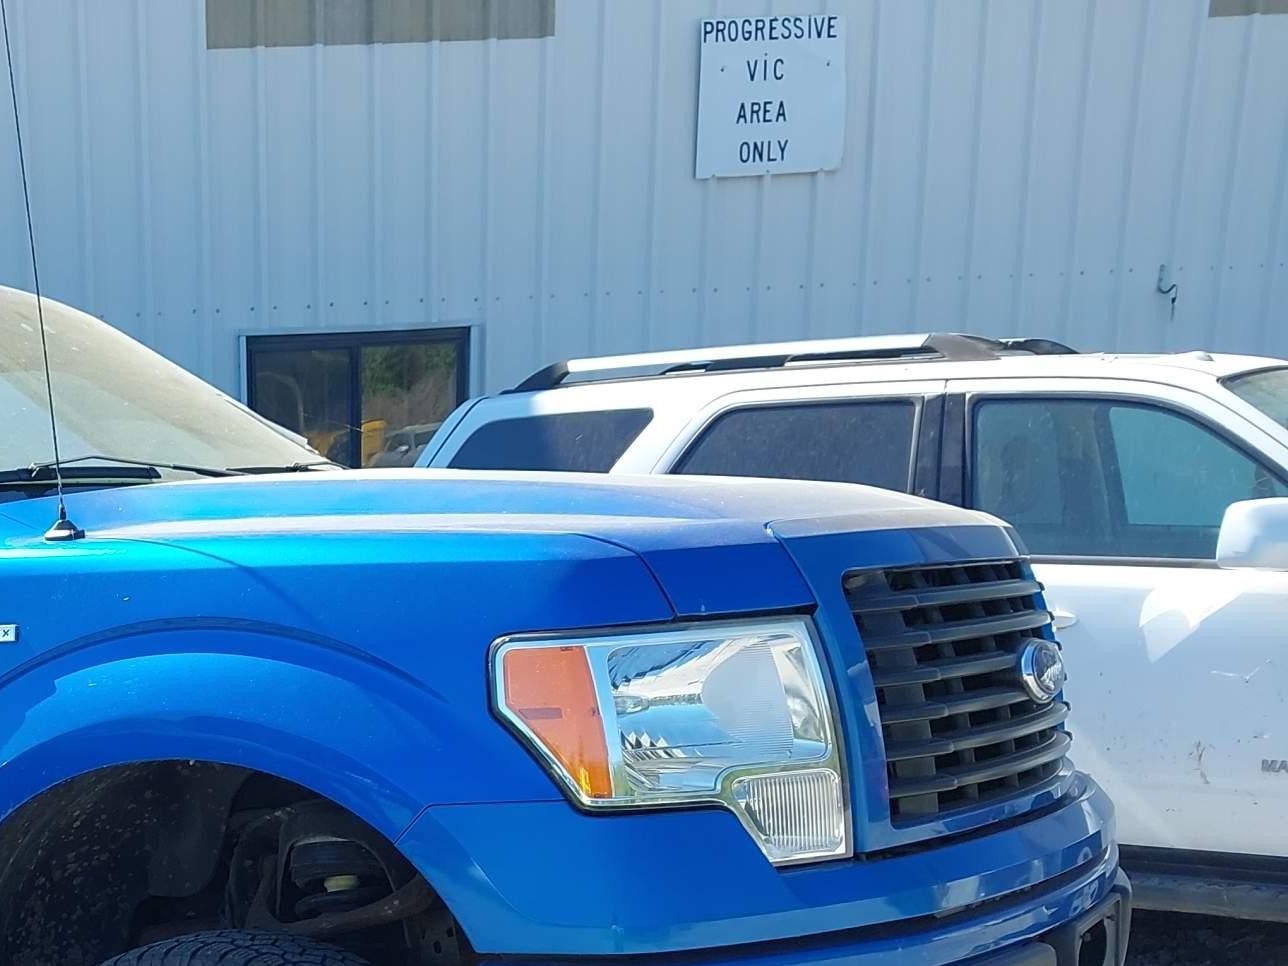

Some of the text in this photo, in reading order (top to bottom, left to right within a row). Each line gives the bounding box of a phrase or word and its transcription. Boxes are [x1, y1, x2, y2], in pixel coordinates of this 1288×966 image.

[703, 16, 838, 43] PROGRESSIVE
[747, 58, 785, 81] VIC
[736, 101, 787, 124] AREA
[739, 139, 789, 163] ONLY
